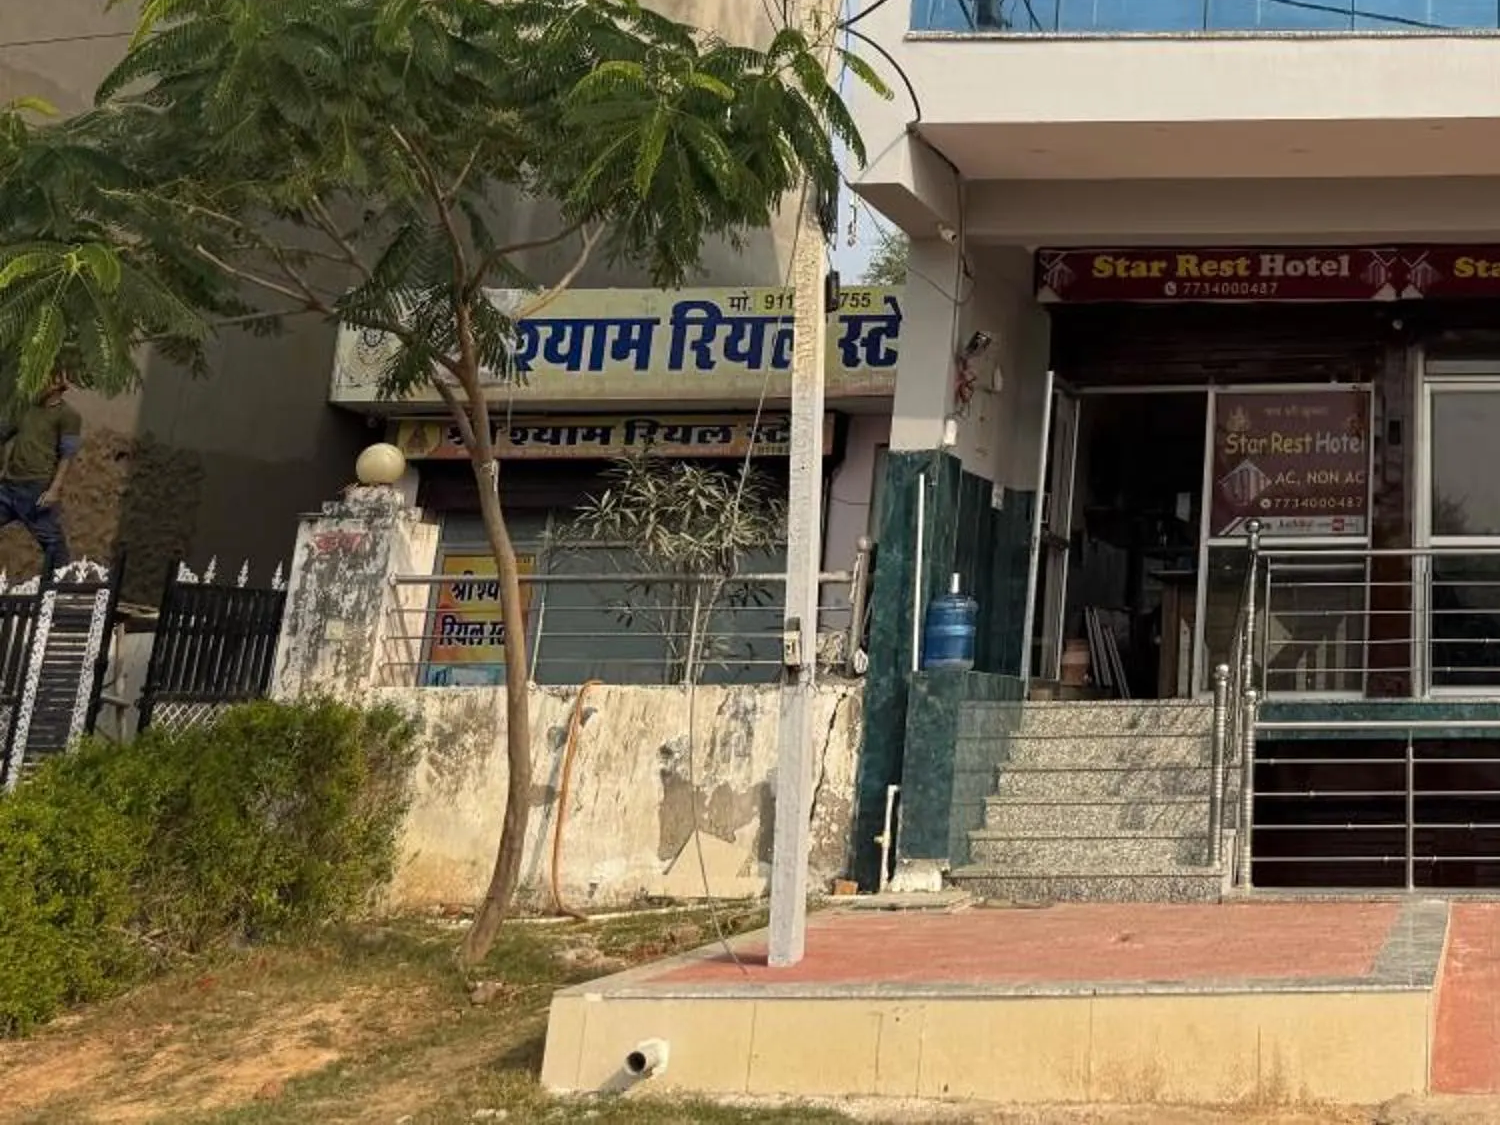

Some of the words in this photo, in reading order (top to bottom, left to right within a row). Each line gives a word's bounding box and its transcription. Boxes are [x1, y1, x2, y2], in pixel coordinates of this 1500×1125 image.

[1092, 254, 1168, 279] Star
[1175, 253, 1251, 279] Rest
[1258, 252, 1351, 277] Hotel
[516, 317, 661, 372] श्याम
[837, 295, 902, 368] स्टे
[1224, 432, 1268, 455] Star
[1271, 430, 1313, 455] Rest
[1315, 429, 1365, 455] Hotel
[1306, 469, 1340, 485] NON
[1344, 470, 1366, 484] AC
